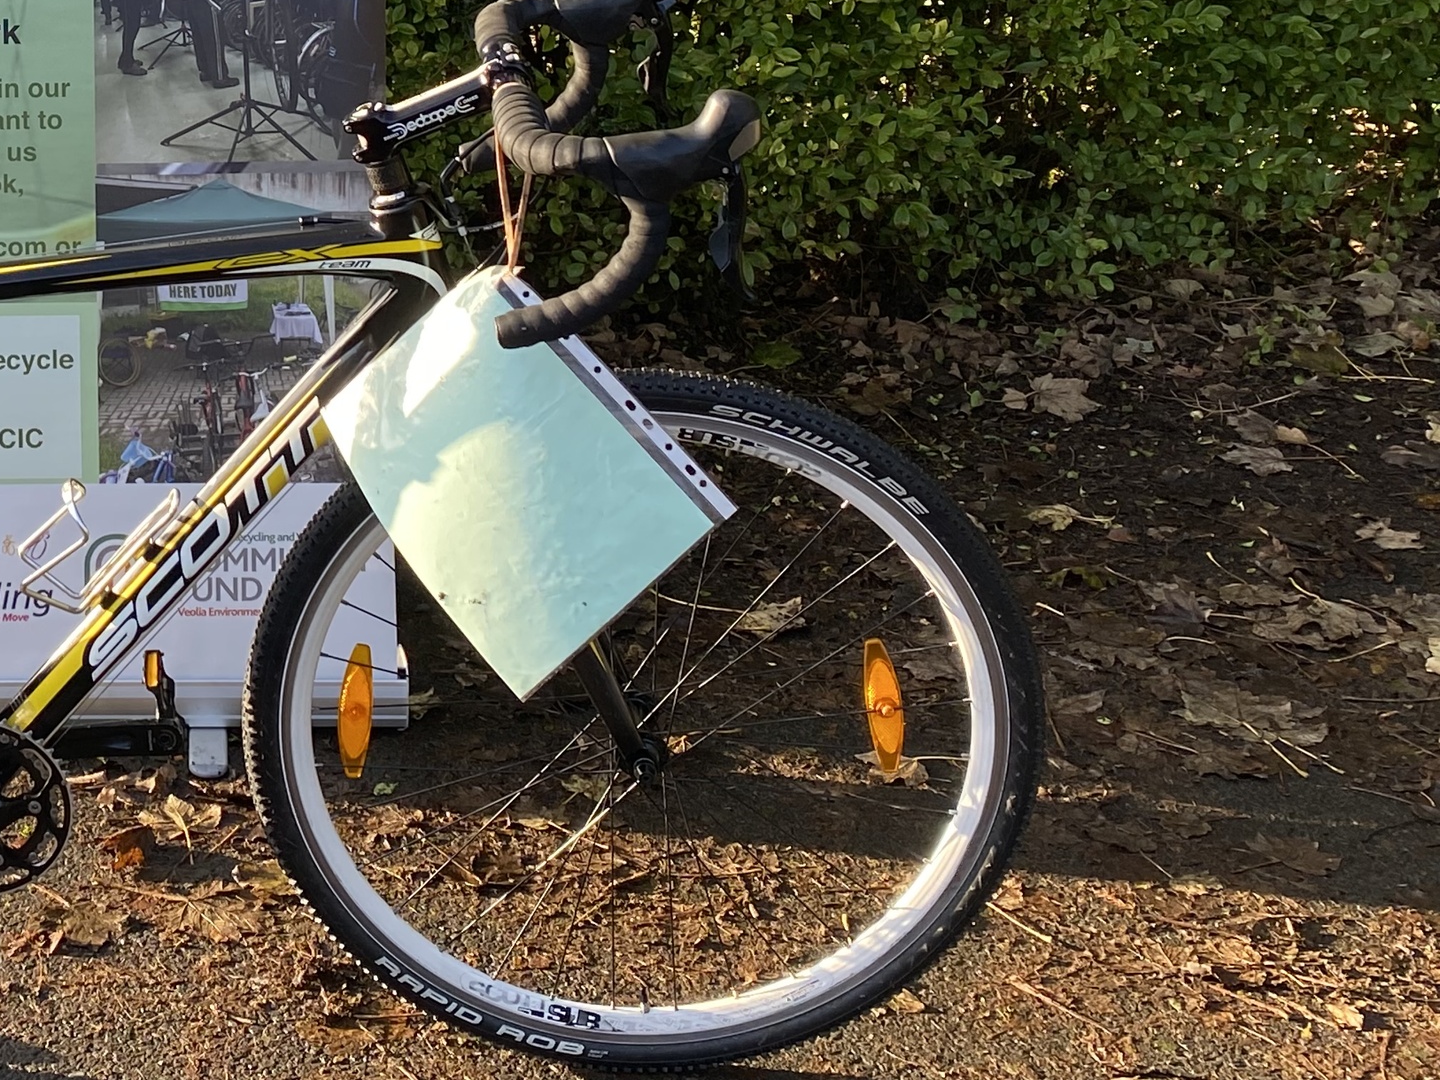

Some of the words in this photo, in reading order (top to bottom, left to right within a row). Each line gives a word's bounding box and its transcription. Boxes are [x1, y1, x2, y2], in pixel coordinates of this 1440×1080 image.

[27, 80, 71, 98] our
[38, 110, 63, 129] to
[7, 145, 37, 162] us
[56, 240, 82, 255] or
[319, 260, 371, 269] team
[169, 285, 197, 298] HERE
[199, 283, 237, 298] TODAY
[709, 404, 930, 515] SCHWALBE
[89, 396, 322, 682] SCOTT
[234, 533, 275, 544] ecycling
[277, 533, 296, 542] and
[191, 577, 263, 603] UND
[2, 612, 29, 623] Move
[178, 607, 207, 617] Veolia
[209, 607, 261, 617] Environme
[375, 956, 483, 1025] RAPID
[496, 1025, 586, 1056] ROB
